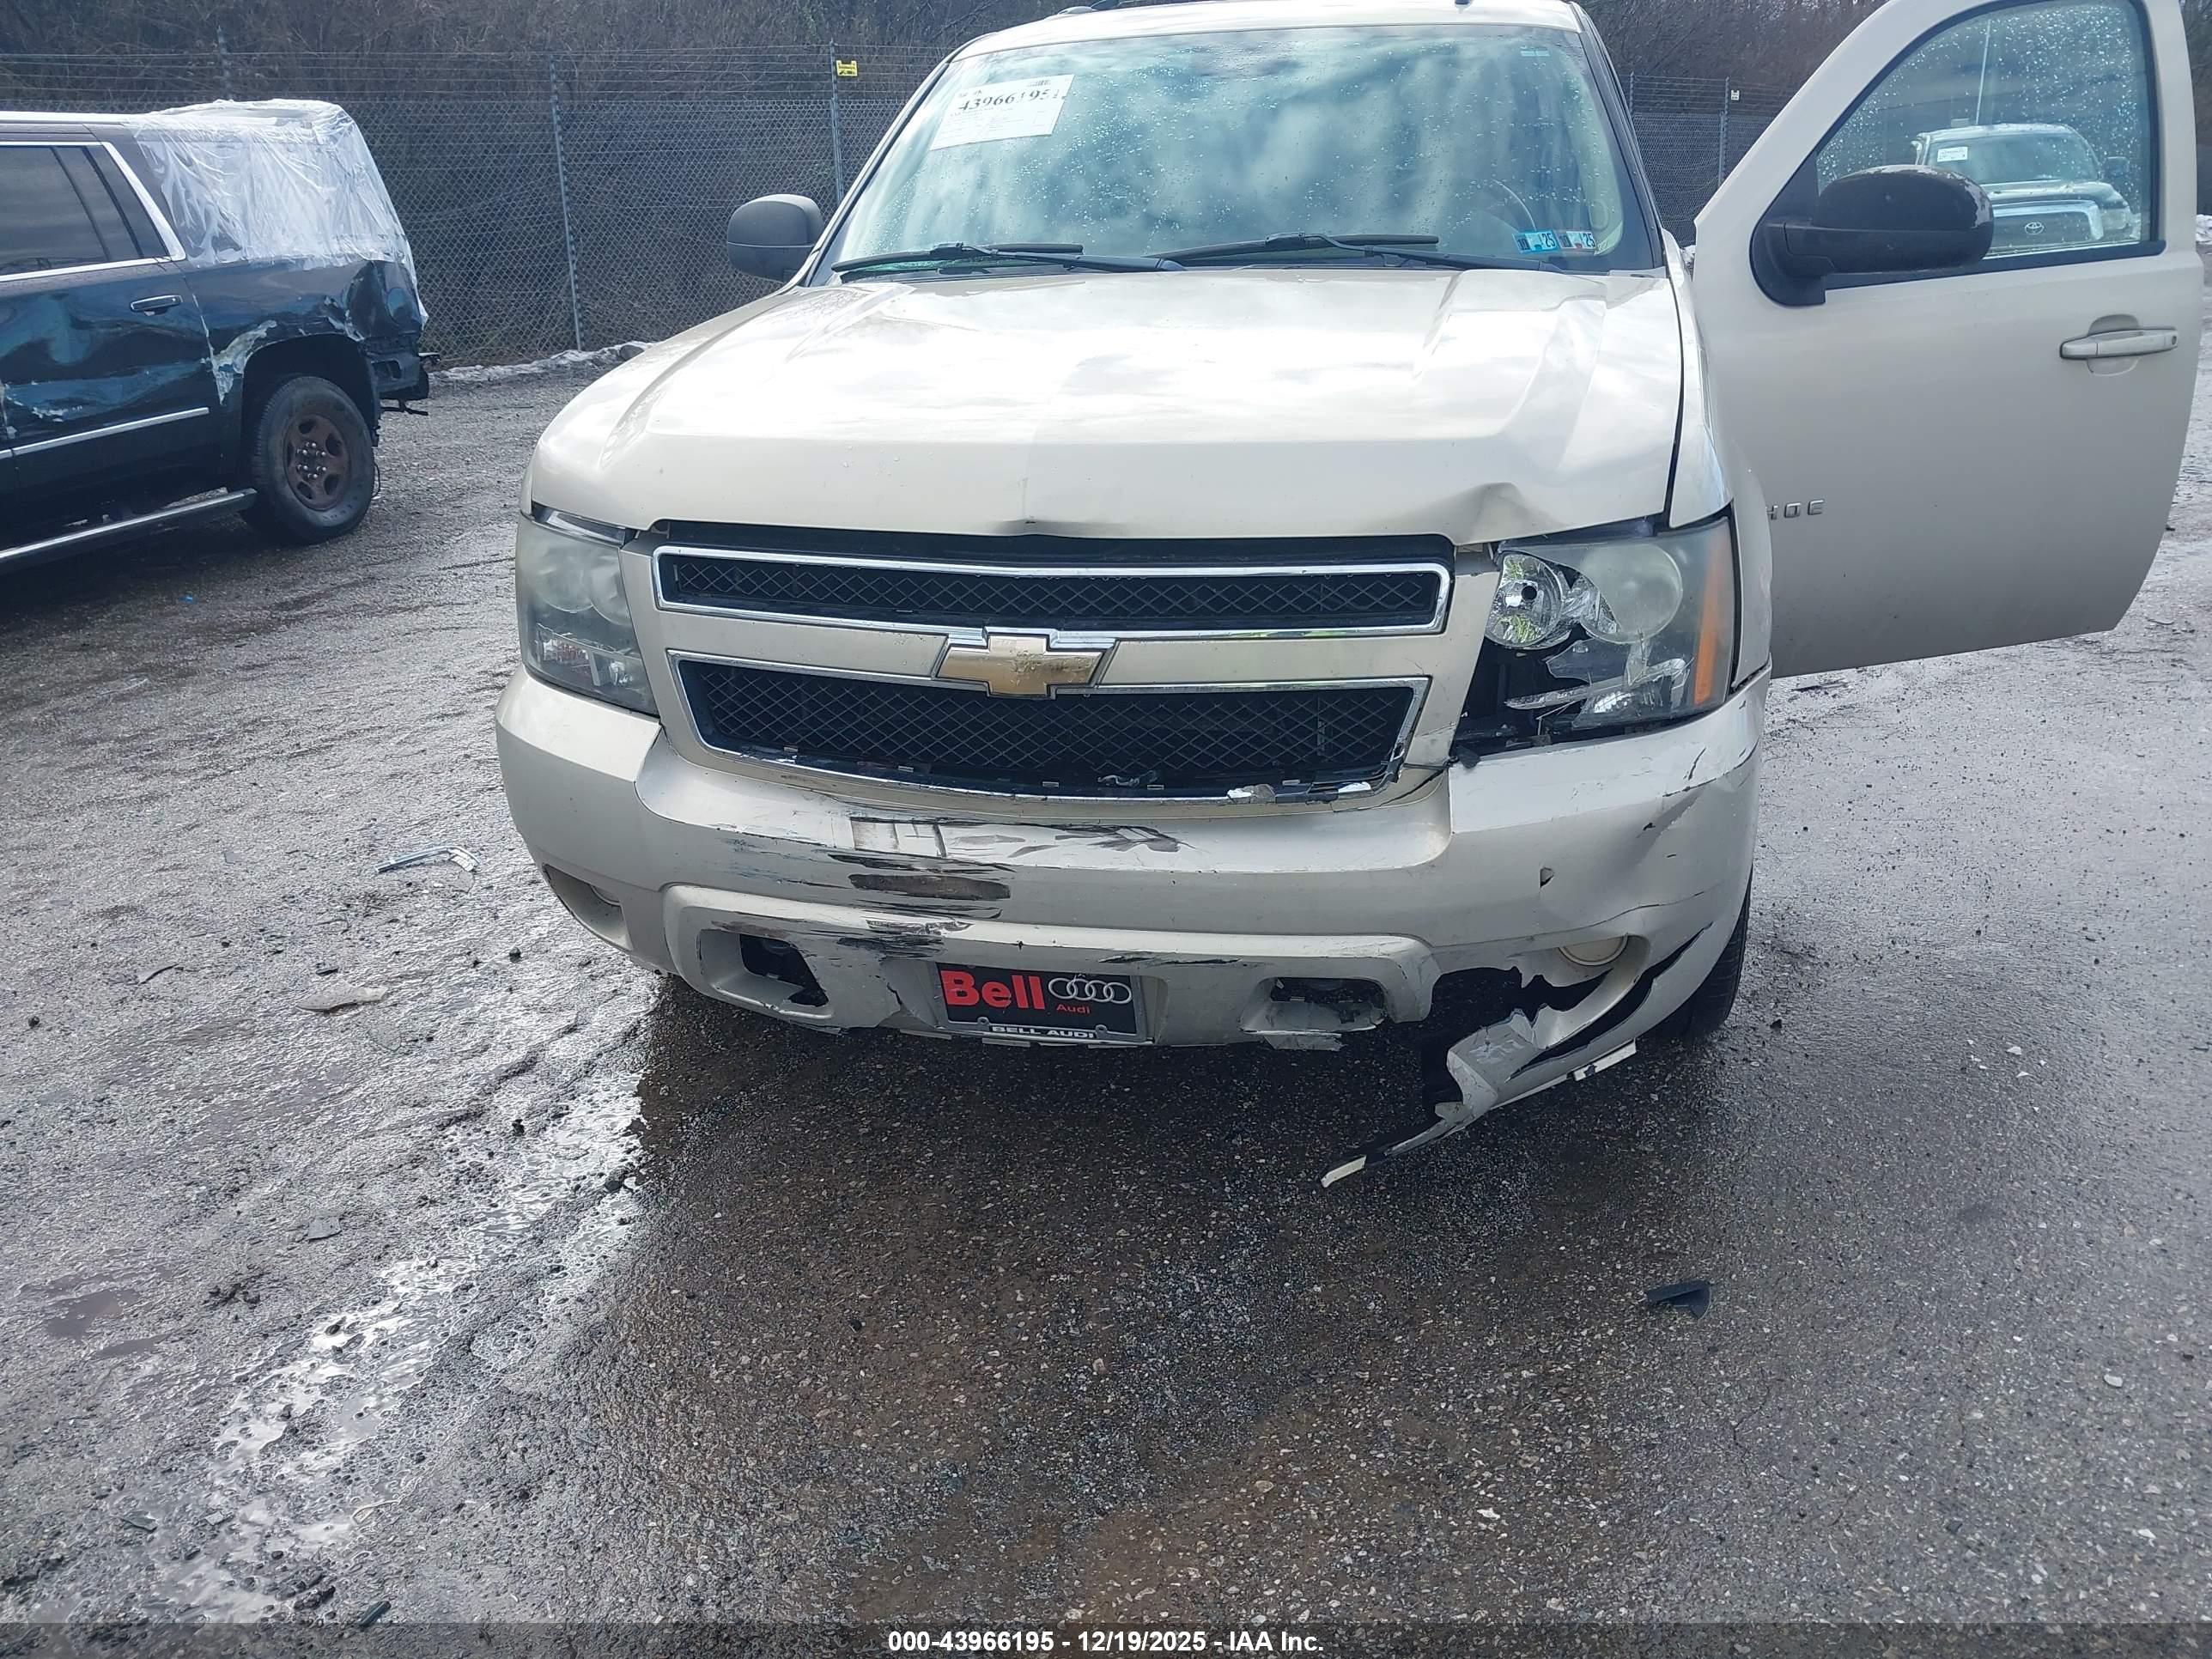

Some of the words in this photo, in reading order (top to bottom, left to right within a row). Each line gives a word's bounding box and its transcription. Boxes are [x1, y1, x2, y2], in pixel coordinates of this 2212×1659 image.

[1542, 233, 1556, 248] 25
[1583, 233, 1596, 248] 25
[1765, 498, 1825, 520] HOE
[940, 969, 1045, 1011] Bell
[1056, 1004, 1091, 1014] Audi
[992, 1025, 1042, 1036] BELL
[1046, 1029, 1095, 1038] AUDI
